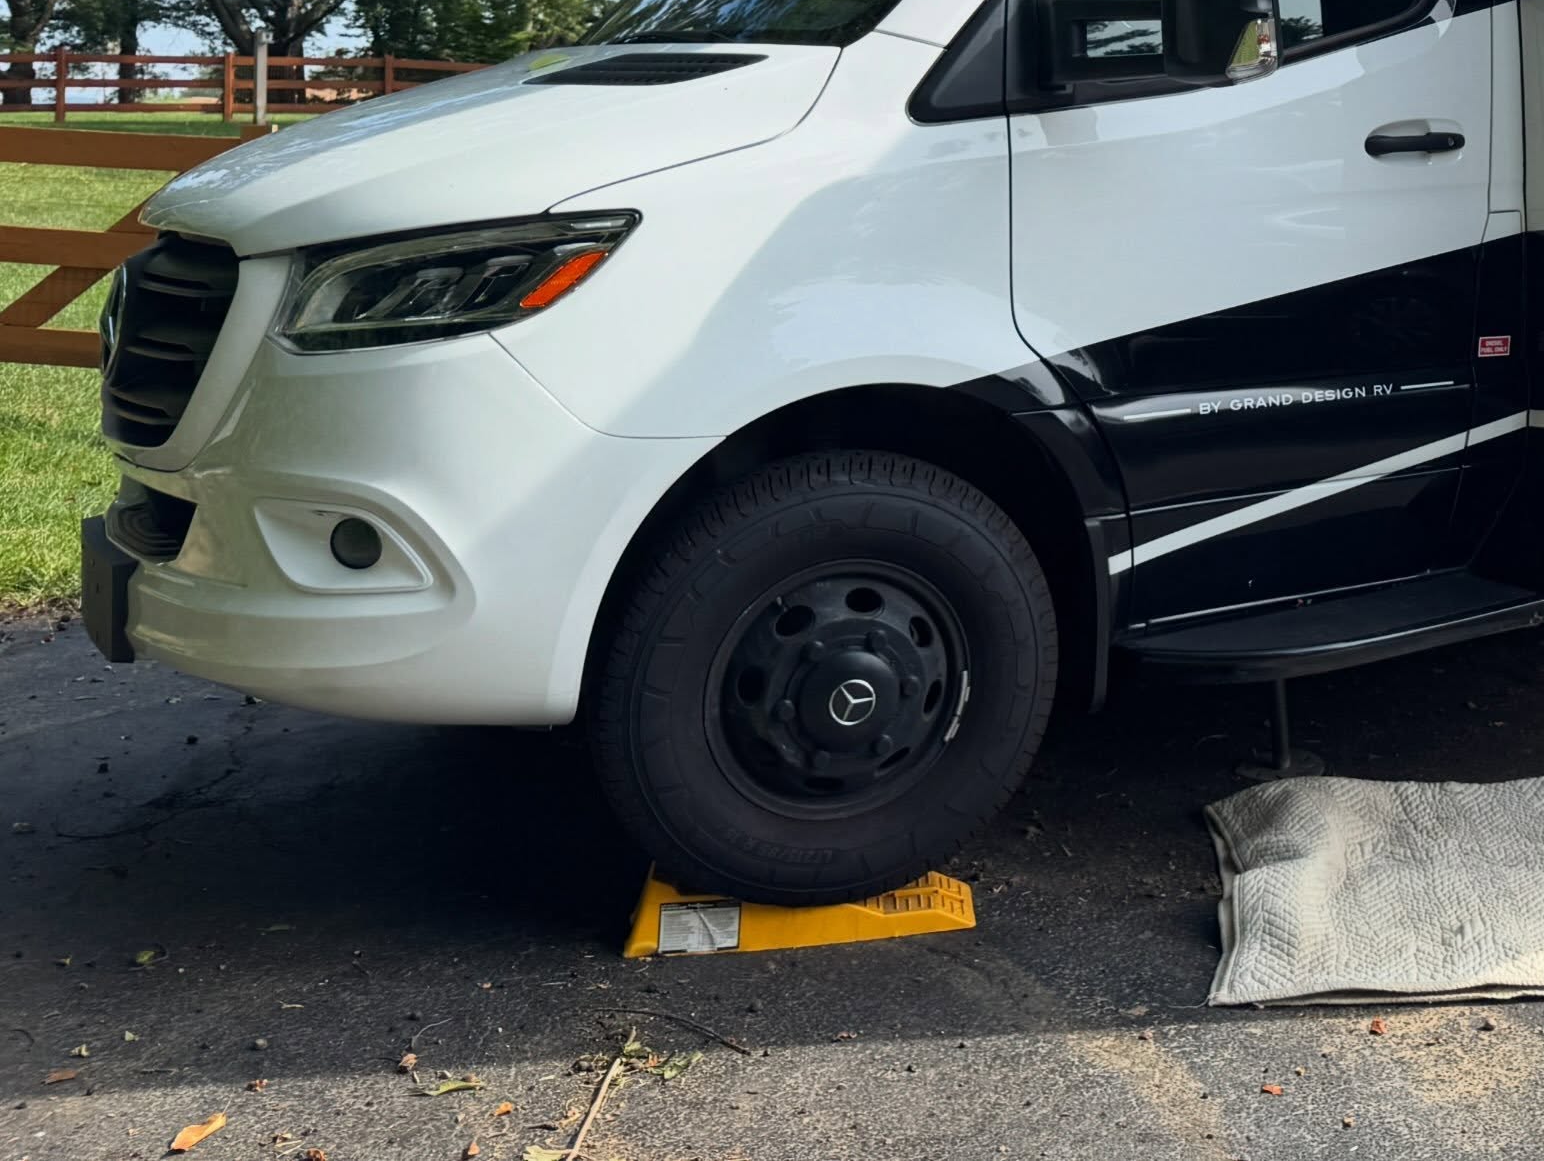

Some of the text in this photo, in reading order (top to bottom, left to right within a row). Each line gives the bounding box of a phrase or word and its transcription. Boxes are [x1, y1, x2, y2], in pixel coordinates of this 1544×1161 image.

[1199, 383, 1393, 415] BY GRAND DESIGN RV
